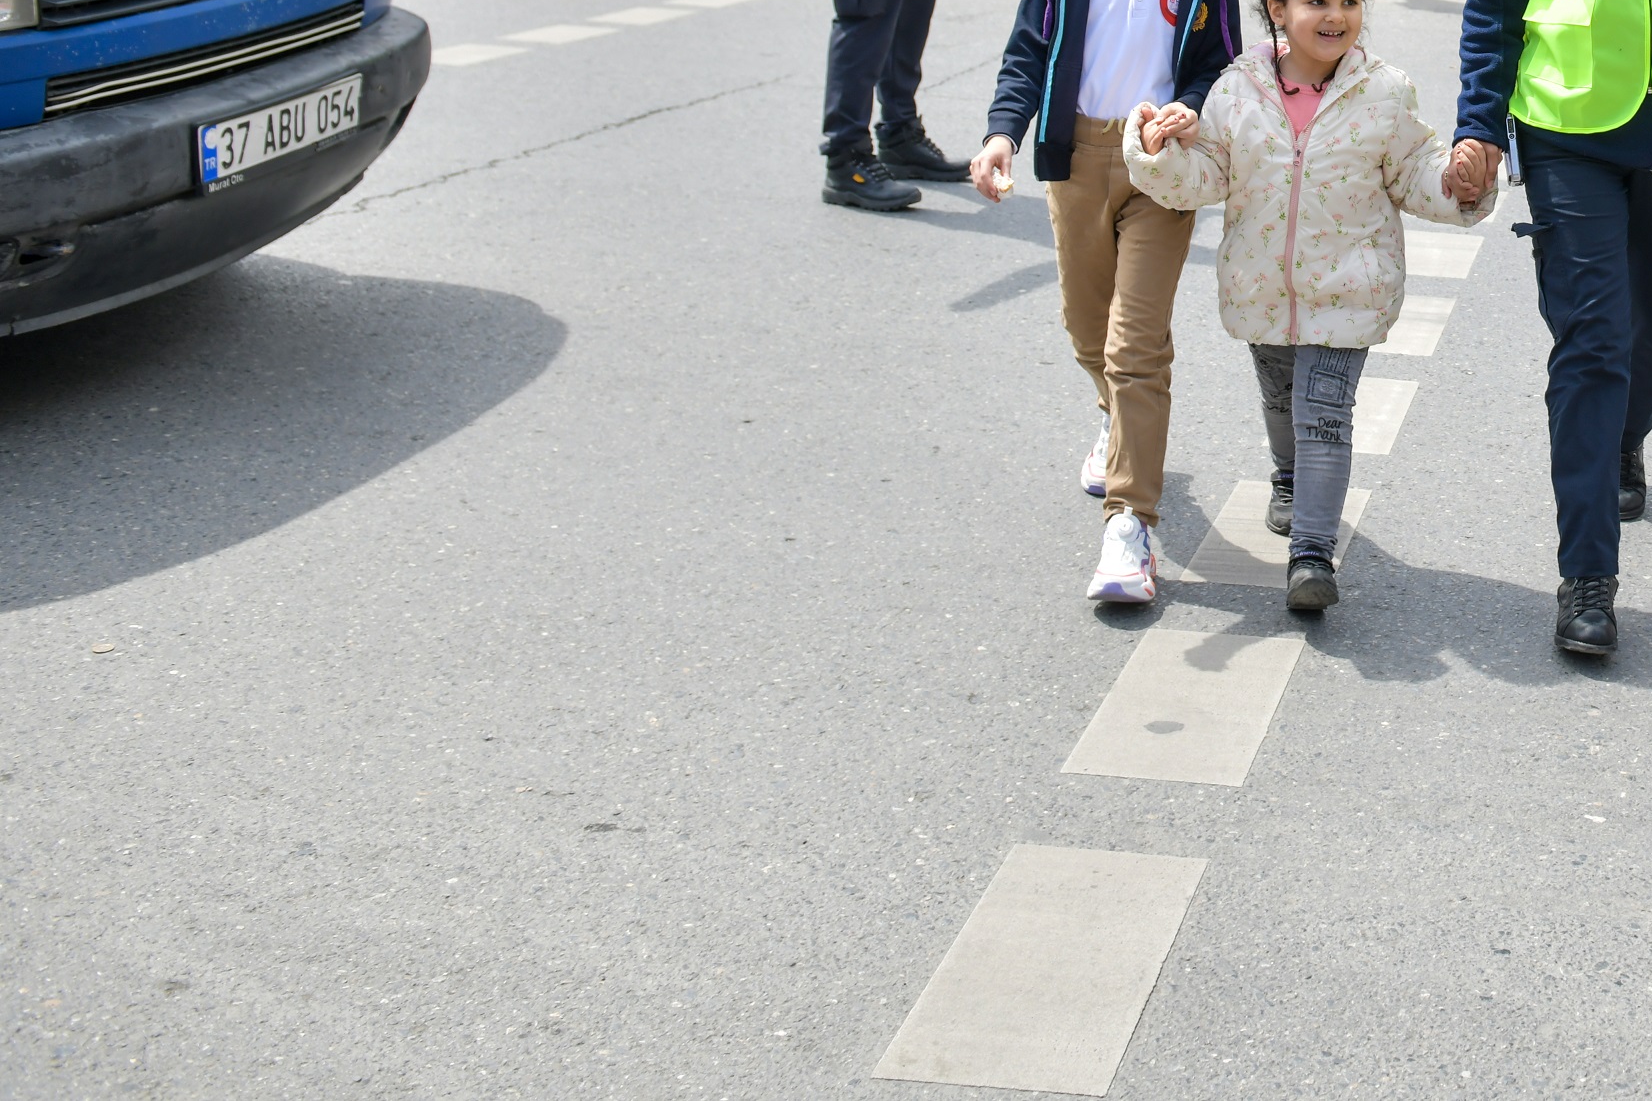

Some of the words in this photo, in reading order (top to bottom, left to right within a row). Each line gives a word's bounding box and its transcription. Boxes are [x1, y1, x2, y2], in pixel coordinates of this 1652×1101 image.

[220, 120, 250, 170] 37
[263, 102, 306, 155] ABU
[317, 85, 355, 134] 054
[204, 157, 217, 171] TR
[208, 179, 230, 193] Murat
[230, 174, 244, 185] Oto
[1317, 417, 1344, 429] Dear
[1306, 426, 1344, 444] Thank
